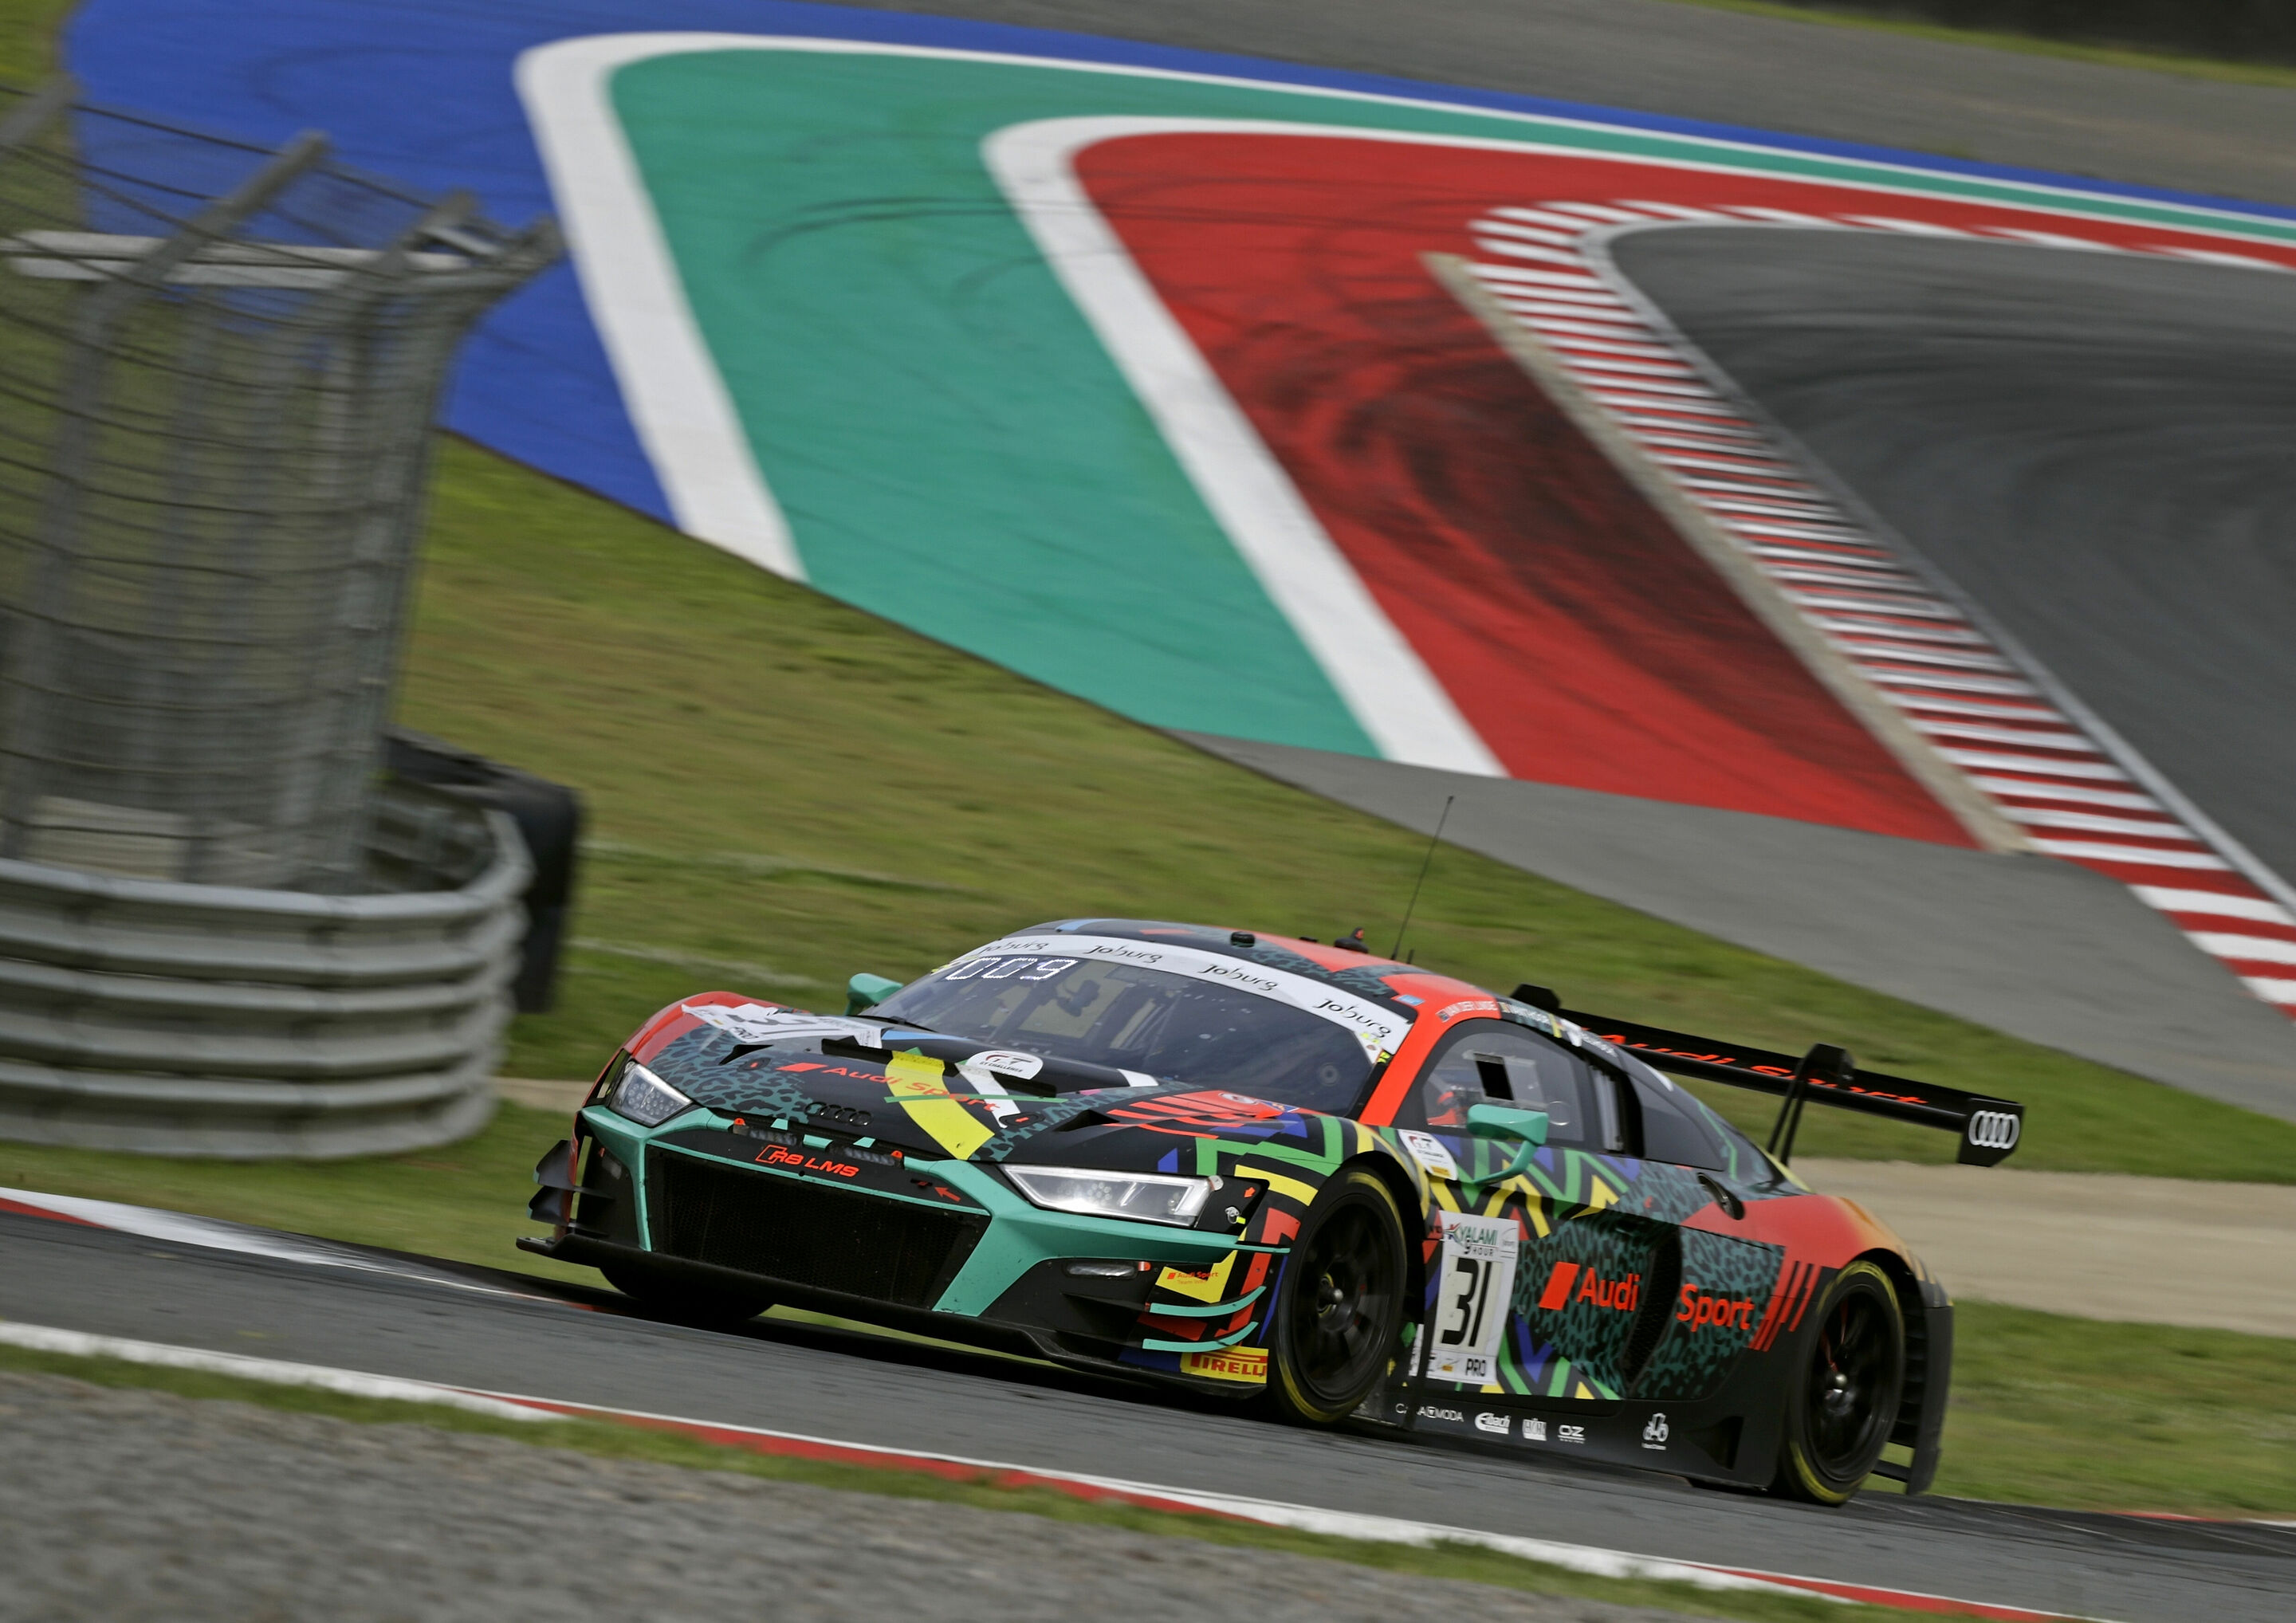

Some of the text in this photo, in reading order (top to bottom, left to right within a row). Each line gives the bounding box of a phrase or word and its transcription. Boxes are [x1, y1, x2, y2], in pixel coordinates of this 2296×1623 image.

[1083, 944, 1162, 964] Joburg
[1198, 963, 1279, 991] Joburg
[1314, 997, 1392, 1039] Joburg
[820, 1067, 1001, 1112] Audi Sport
[765, 1148, 860, 1177] R8 LMS
[1441, 1257, 1493, 1348] 31
[1576, 1267, 1755, 1332] Audi Sport
[1465, 1358, 1487, 1377] PRO
[1559, 1424, 1585, 1437] OZ
